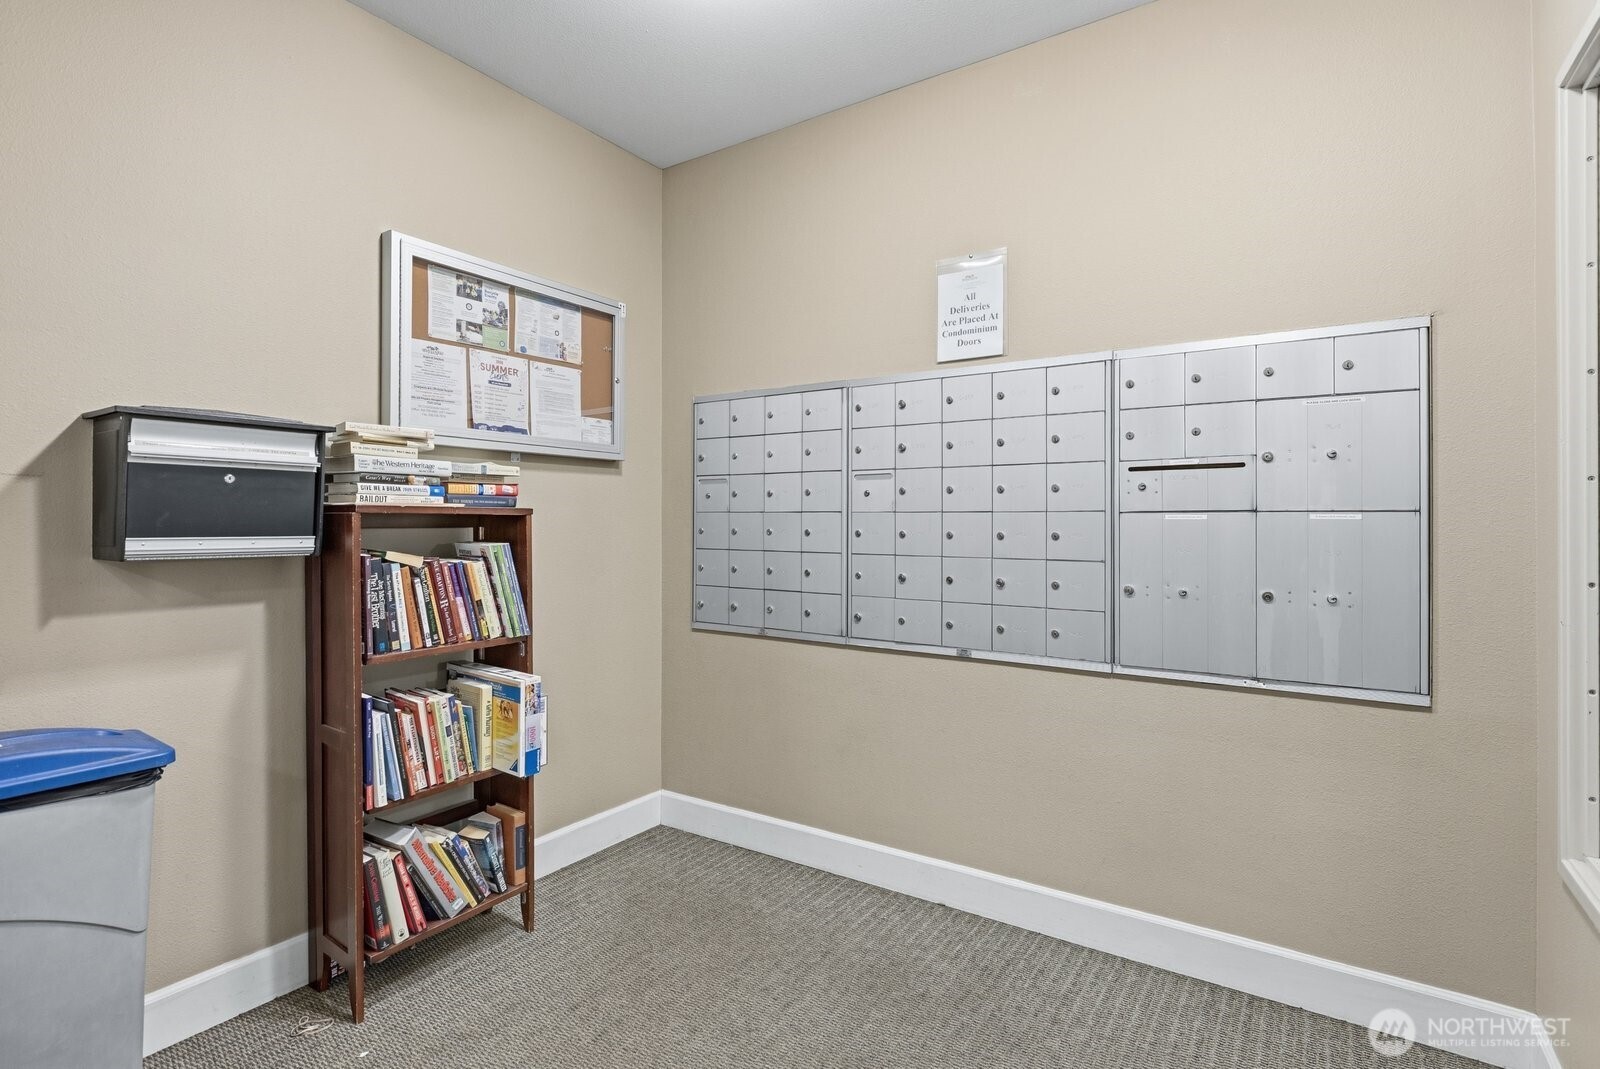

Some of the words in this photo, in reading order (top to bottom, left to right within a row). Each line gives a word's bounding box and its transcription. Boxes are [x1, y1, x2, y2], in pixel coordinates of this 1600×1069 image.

[964, 292, 976, 300] All
[950, 302, 990, 314] Deliveries
[960, 314, 986, 324] Placed
[988, 312, 999, 320] At
[942, 324, 998, 338] Condominium
[957, 338, 982, 348] Doors
[480, 362, 519, 377] SUMMER
[372, 458, 385, 466] The
[411, 462, 435, 470] Heritage
[360, 495, 387, 503] BAILOUT
[370, 572, 378, 587] The
[436, 572, 446, 599] GRAFTON
[439, 598, 448, 608] R
[371, 603, 380, 628] Brother
[412, 838, 437, 874] Alternative
[432, 870, 456, 903] Medicine
